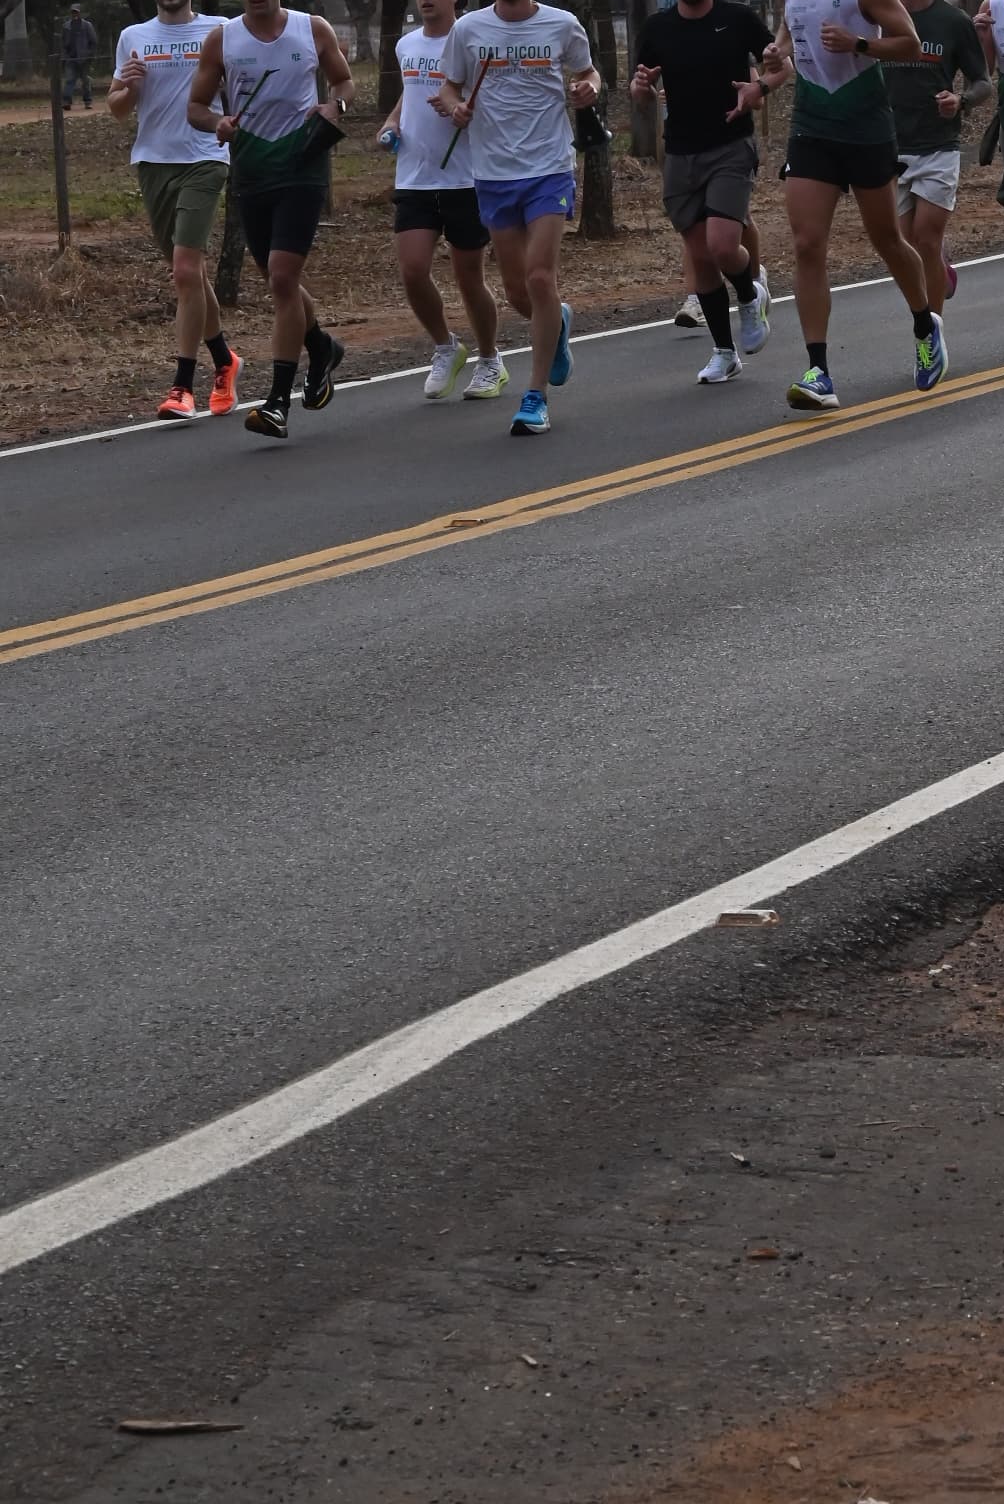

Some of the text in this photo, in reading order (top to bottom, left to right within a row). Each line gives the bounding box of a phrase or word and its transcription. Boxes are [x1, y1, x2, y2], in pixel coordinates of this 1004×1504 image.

[144, 44, 164, 56] DAL
[479, 45, 552, 59] DAL PICOLO
